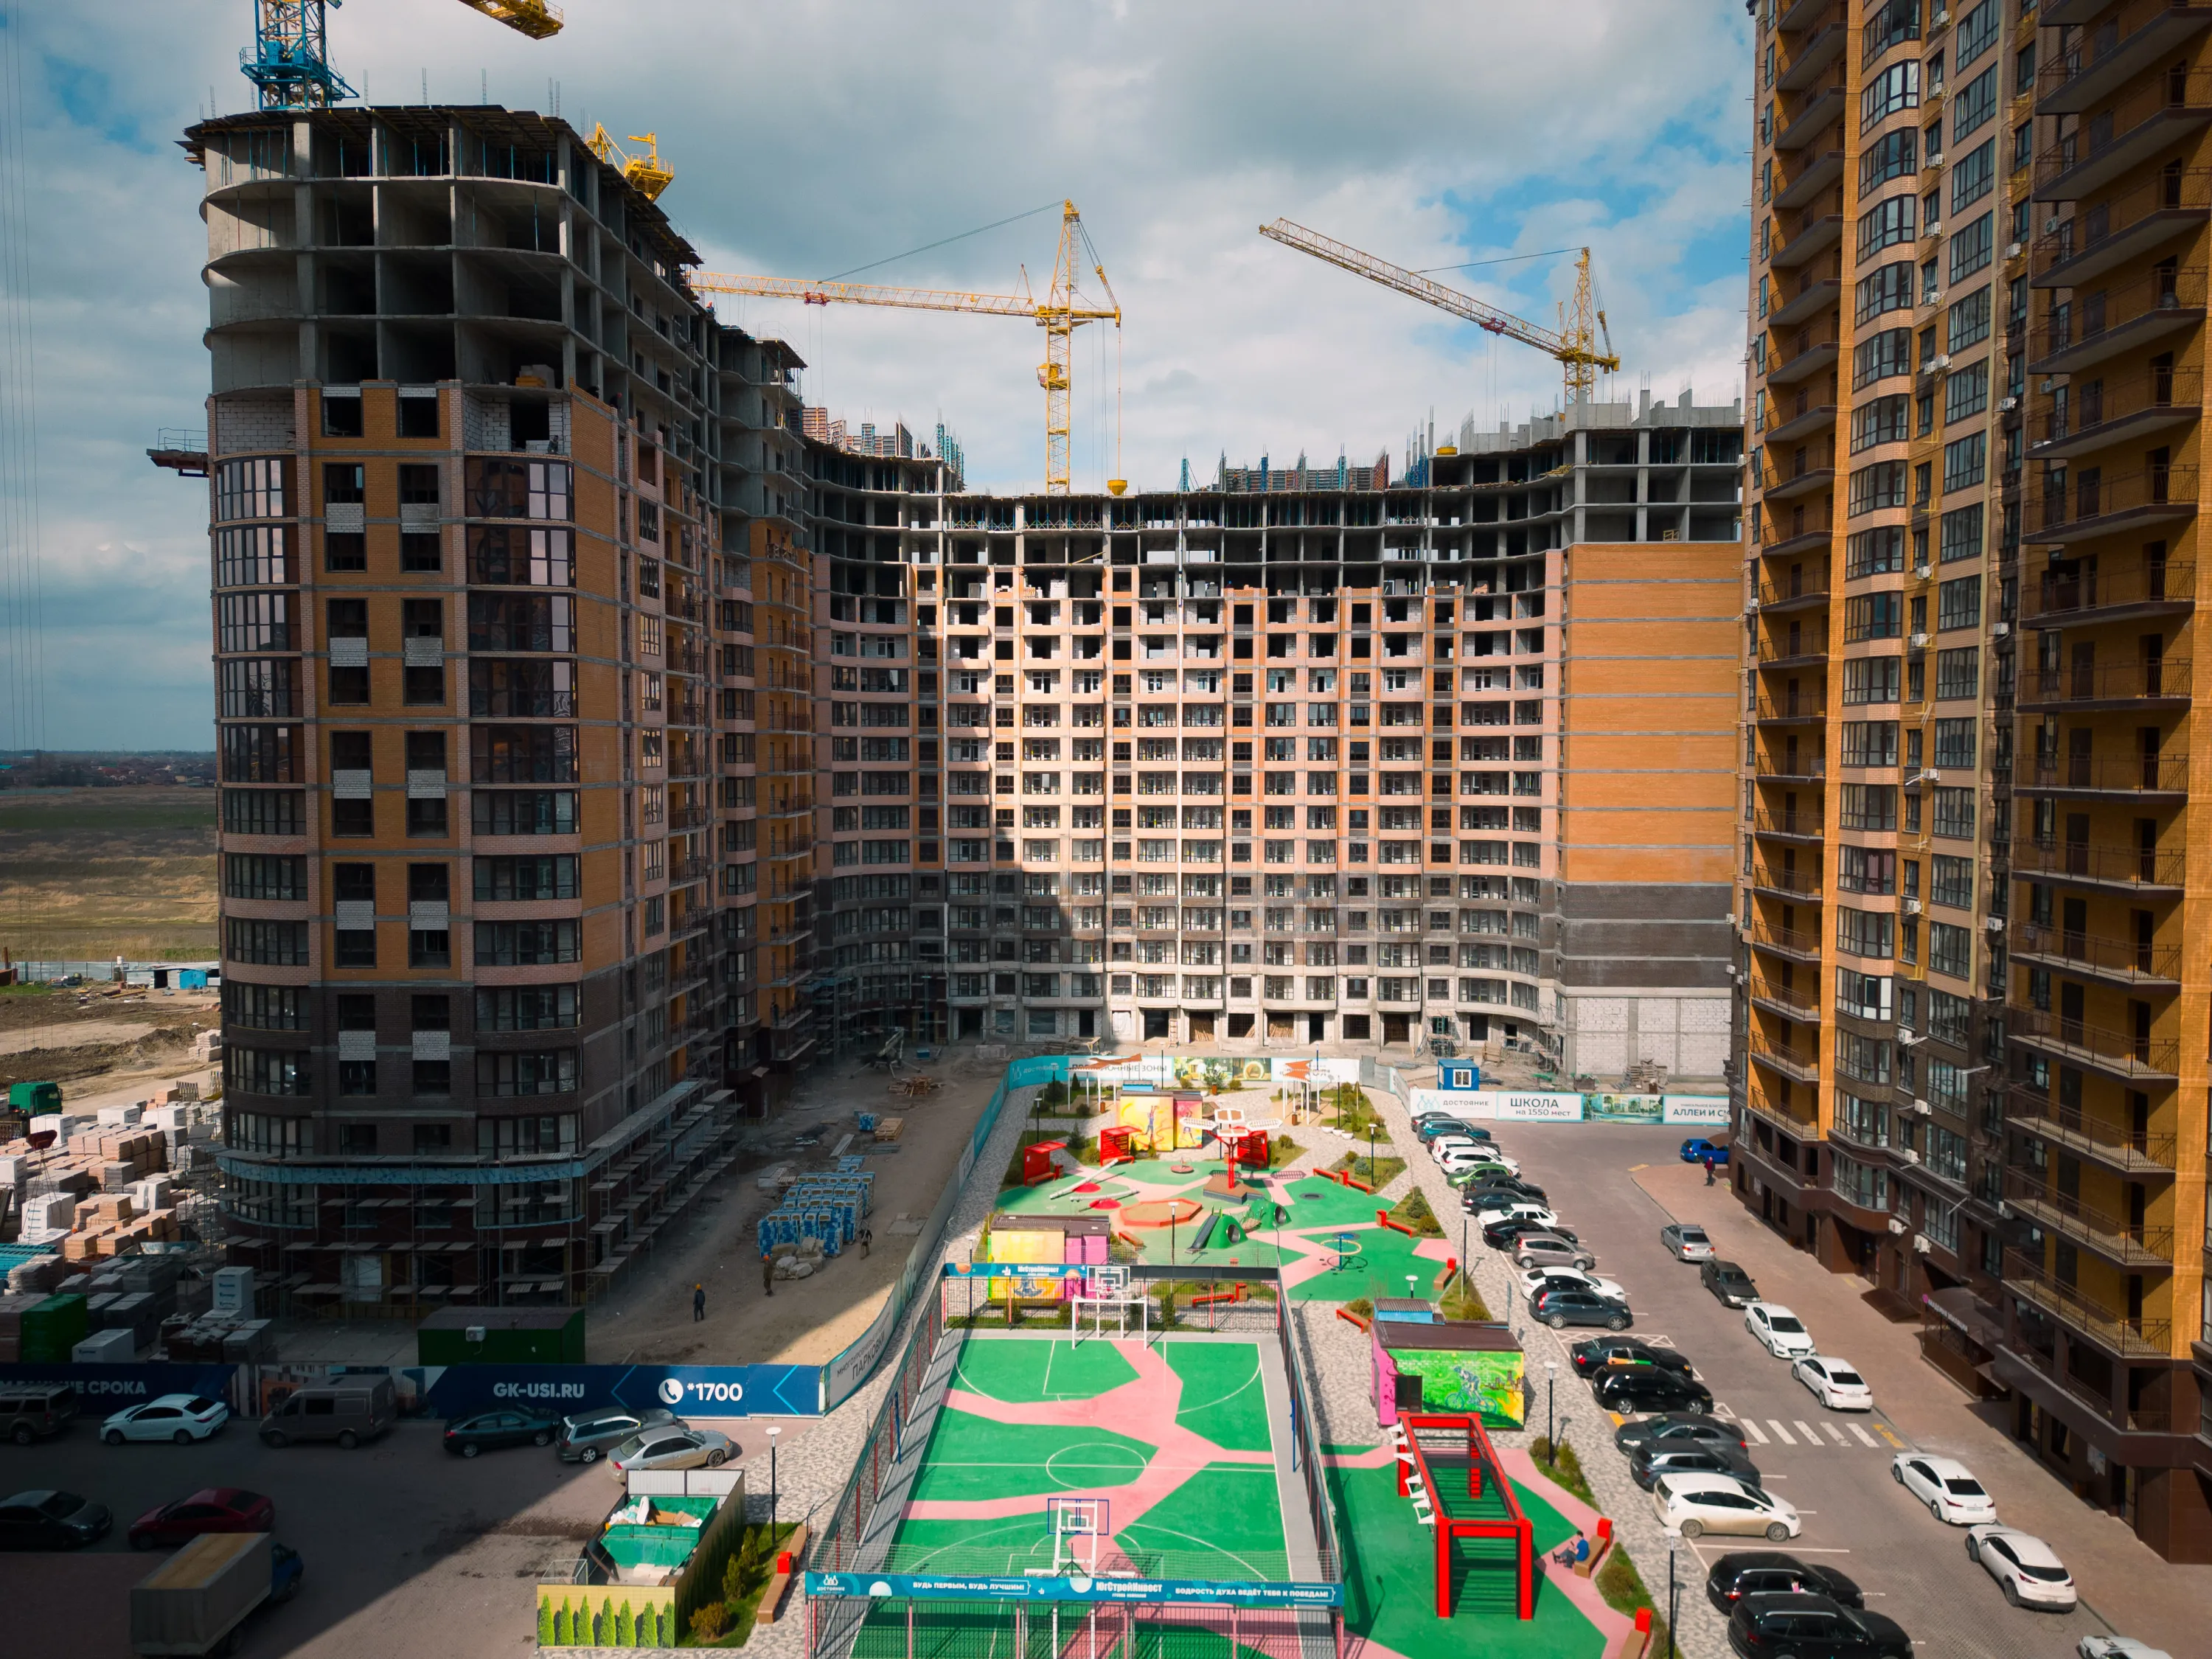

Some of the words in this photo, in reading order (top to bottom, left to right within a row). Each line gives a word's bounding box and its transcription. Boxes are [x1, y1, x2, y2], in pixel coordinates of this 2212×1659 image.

[1510, 1097, 1559, 1108] ШКОЛА
[1672, 1108, 1707, 1116] АЛЛЕИ
[852, 1329, 886, 1380] ПАРКОВКИ
[88, 1380, 147, 1395] СРОКА
[493, 1382, 585, 1398] GK-USI.RU
[1096, 1582, 1163, 1593] ЮгСтройИнвест
